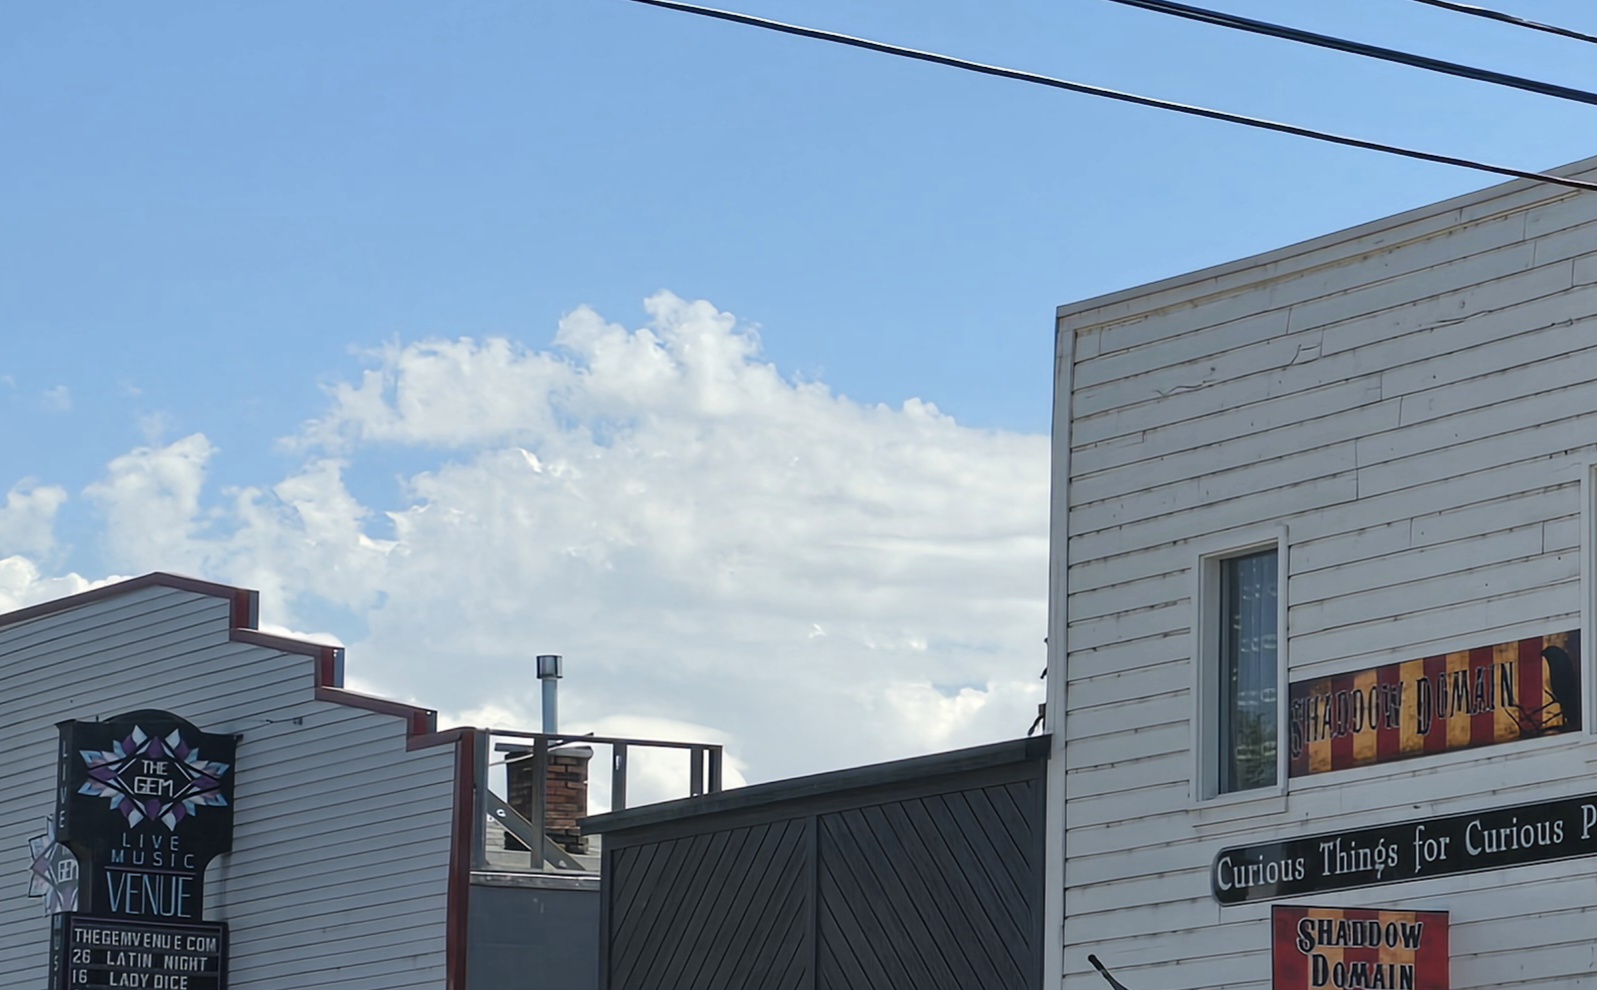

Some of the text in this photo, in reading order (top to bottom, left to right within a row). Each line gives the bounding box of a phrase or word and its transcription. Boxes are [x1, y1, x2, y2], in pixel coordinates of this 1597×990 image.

[1290, 661, 1516, 760] SHADDOW DOMAIN
[141, 759, 169, 776] THE
[133, 776, 174, 798] GEM
[122, 832, 180, 851] LIVE
[111, 849, 195, 869] MUSIC
[1216, 855, 1305, 892] Curious
[1319, 837, 1399, 879] Things
[1413, 825, 1450, 873] for
[1465, 819, 1564, 857] Curious
[106, 870, 194, 918] VENUE
[1296, 916, 1424, 955] SHADDOW
[106, 951, 152, 968] LATIN
[164, 955, 208, 971] NIGHT
[1311, 953, 1415, 990] DOMAIN
[72, 969, 188, 990] 16 LADY DICE
